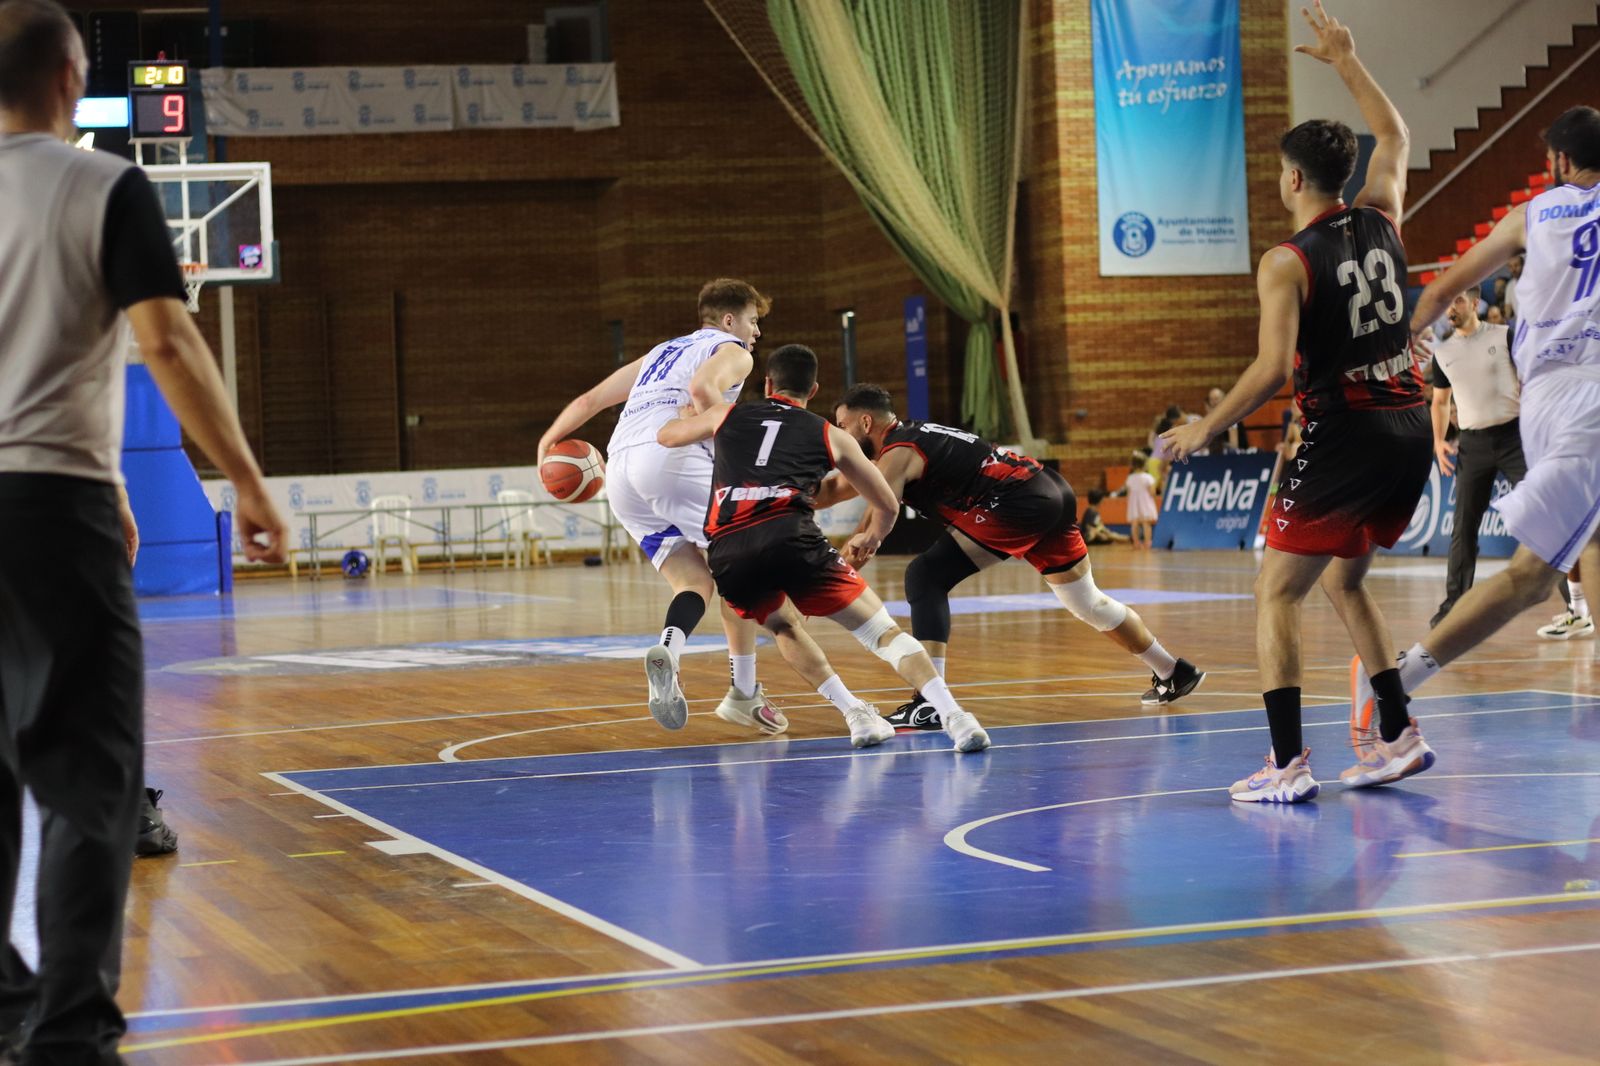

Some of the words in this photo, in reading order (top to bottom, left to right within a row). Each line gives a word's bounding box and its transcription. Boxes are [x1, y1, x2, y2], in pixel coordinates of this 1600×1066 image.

[1115, 56, 1226, 91] Apoyamos
[163, 95, 185, 132] 9
[1118, 88, 1142, 107] tu
[1147, 80, 1228, 115] esfuerzo
[1337, 248, 1404, 338] 23
[755, 420, 782, 466] 1
[1164, 469, 1260, 513] Huelva
[1216, 514, 1250, 533] original
